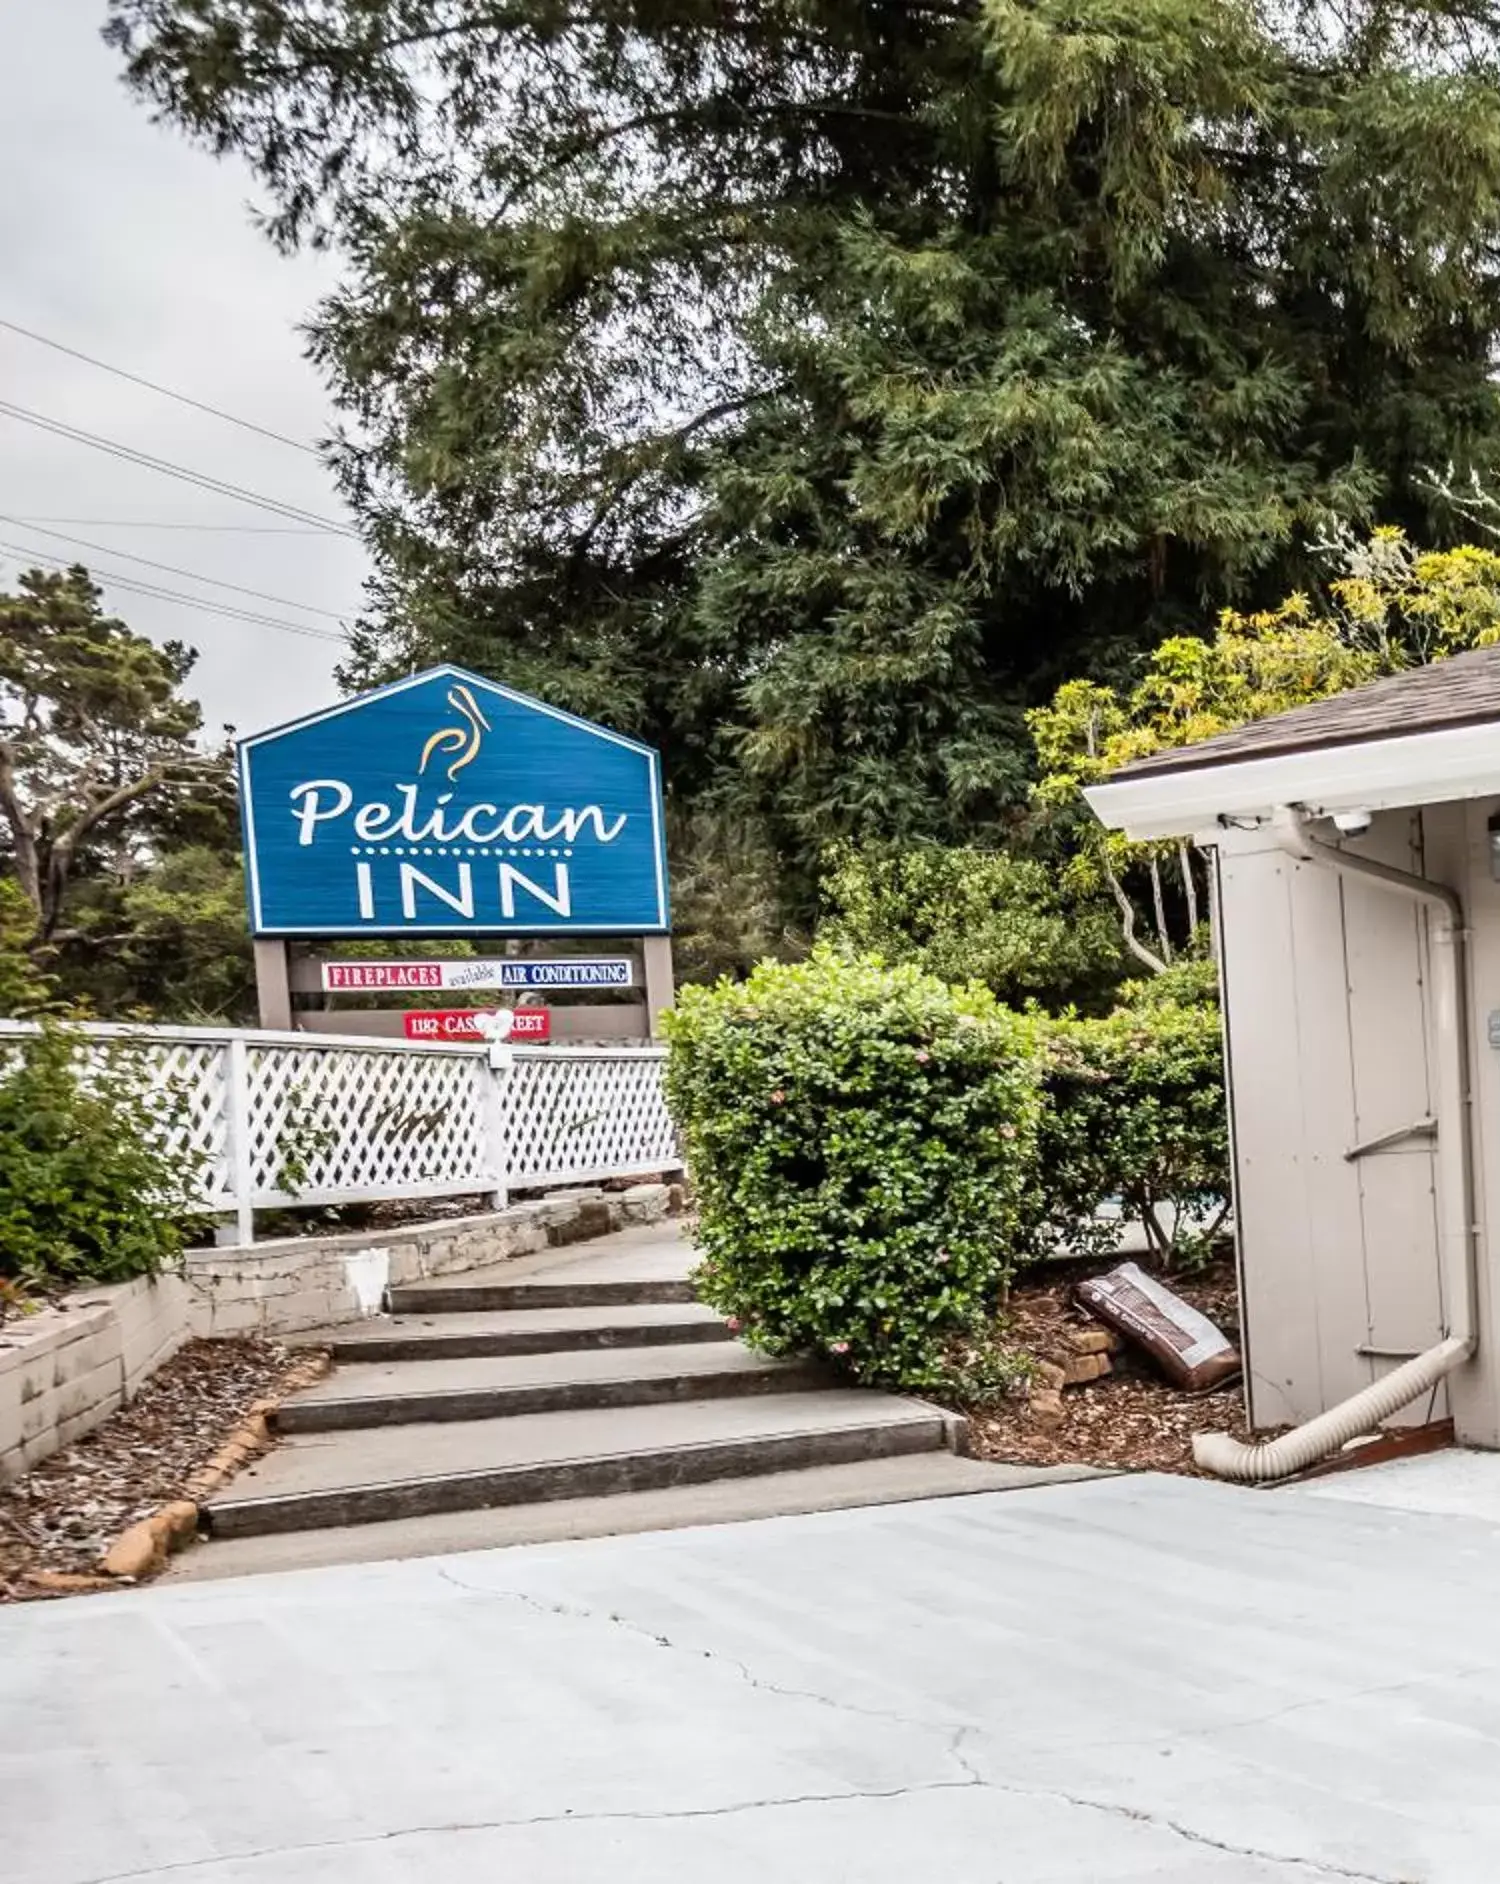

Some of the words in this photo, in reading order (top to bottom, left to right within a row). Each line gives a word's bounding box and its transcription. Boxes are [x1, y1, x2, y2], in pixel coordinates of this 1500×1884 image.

[289, 779, 627, 846] Pelican
[355, 862, 572, 919] INN
[332, 966, 439, 985] FIREPLACES
[449, 964, 495, 987] available
[503, 966, 527, 982] AIR
[531, 965, 626, 982] CONDITIONING
[411, 1018, 439, 1033] 1182
[445, 1017, 484, 1034] CAS
